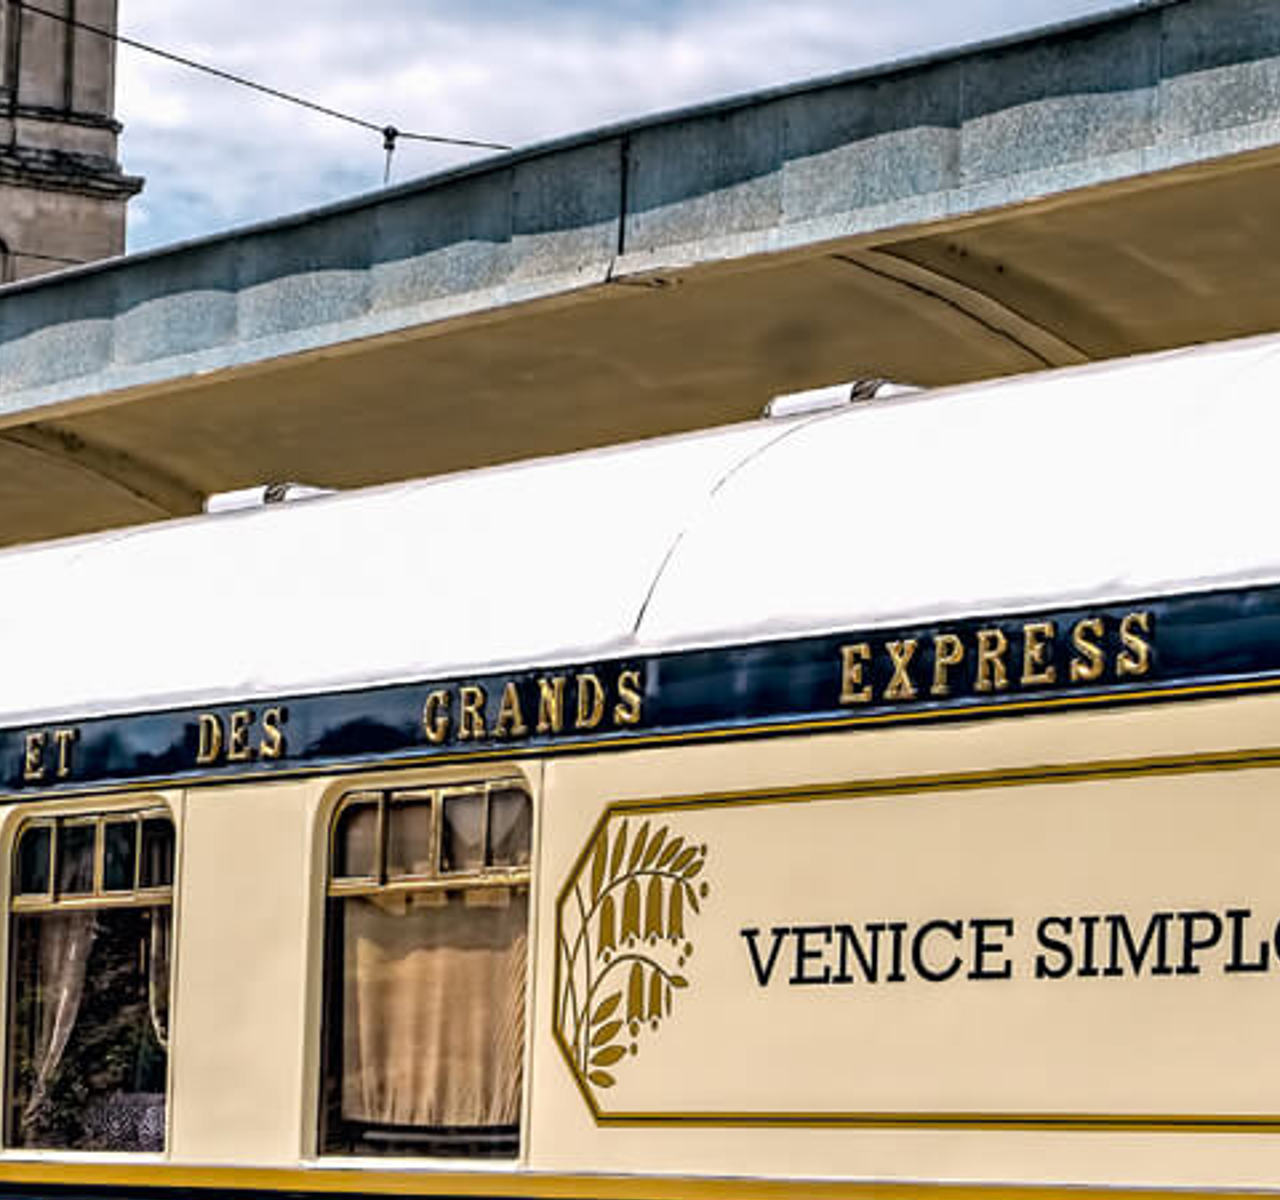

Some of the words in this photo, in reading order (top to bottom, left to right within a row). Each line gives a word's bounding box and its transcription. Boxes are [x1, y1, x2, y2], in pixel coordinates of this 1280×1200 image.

[24, 729, 74, 781] ET
[196, 707, 285, 765] DES
[422, 671, 643, 743] GRANDS
[839, 612, 1151, 705] EXPRESS
[741, 918, 1014, 987] VENICE
